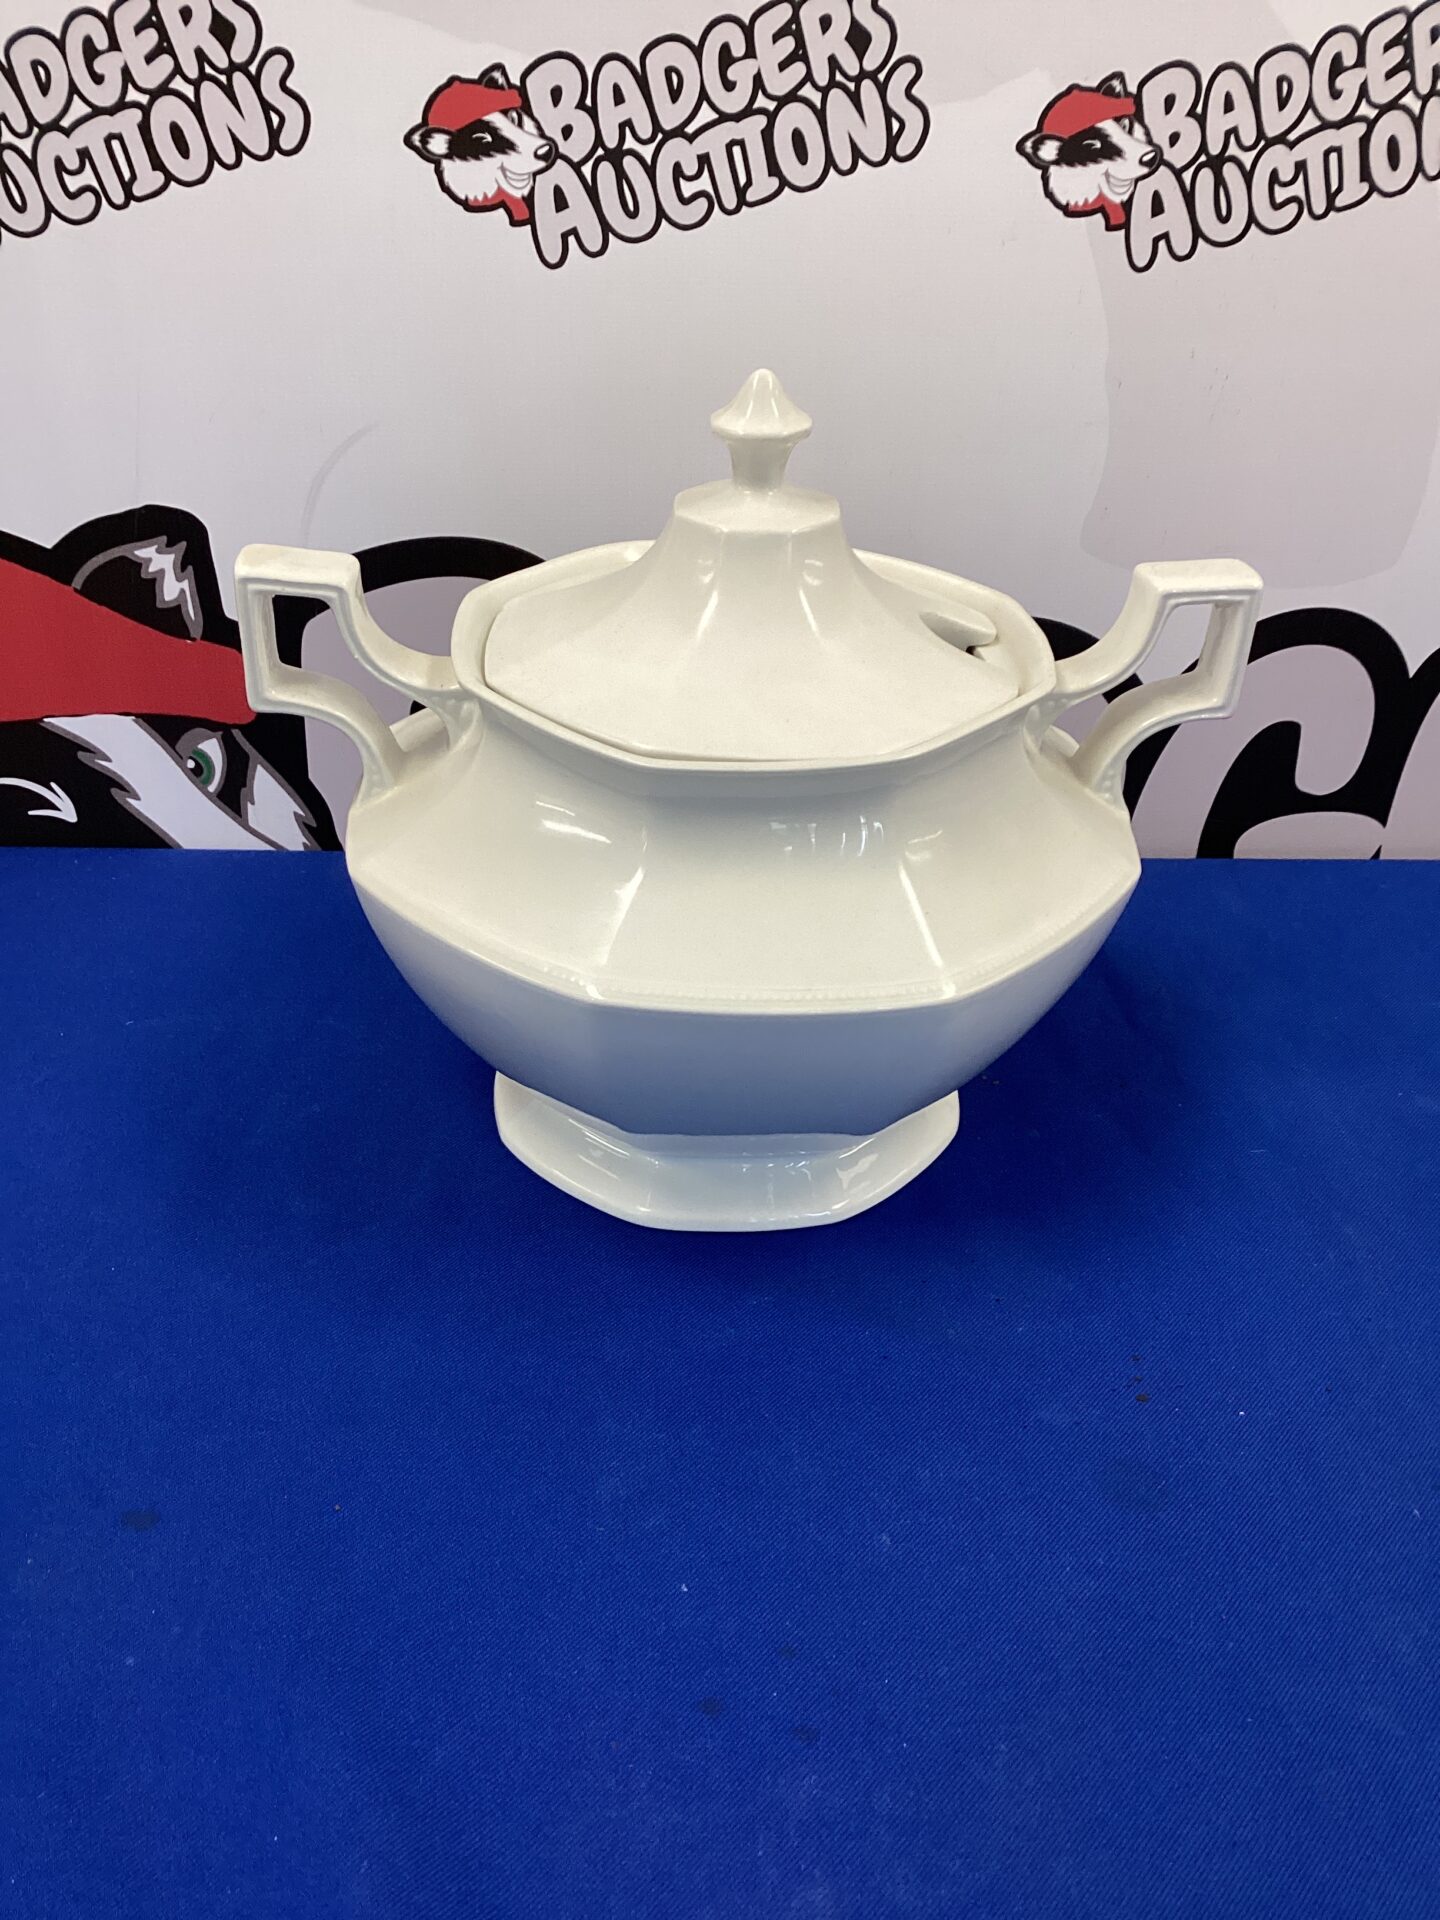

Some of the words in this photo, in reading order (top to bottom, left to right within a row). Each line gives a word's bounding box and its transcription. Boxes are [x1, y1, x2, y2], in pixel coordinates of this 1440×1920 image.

[0, 46, 311, 246] UCTIONS
[519, 0, 897, 166] BADGERS
[531, 54, 930, 270] AUCTIONS
[1125, 95, 1440, 273] AUCTIO
